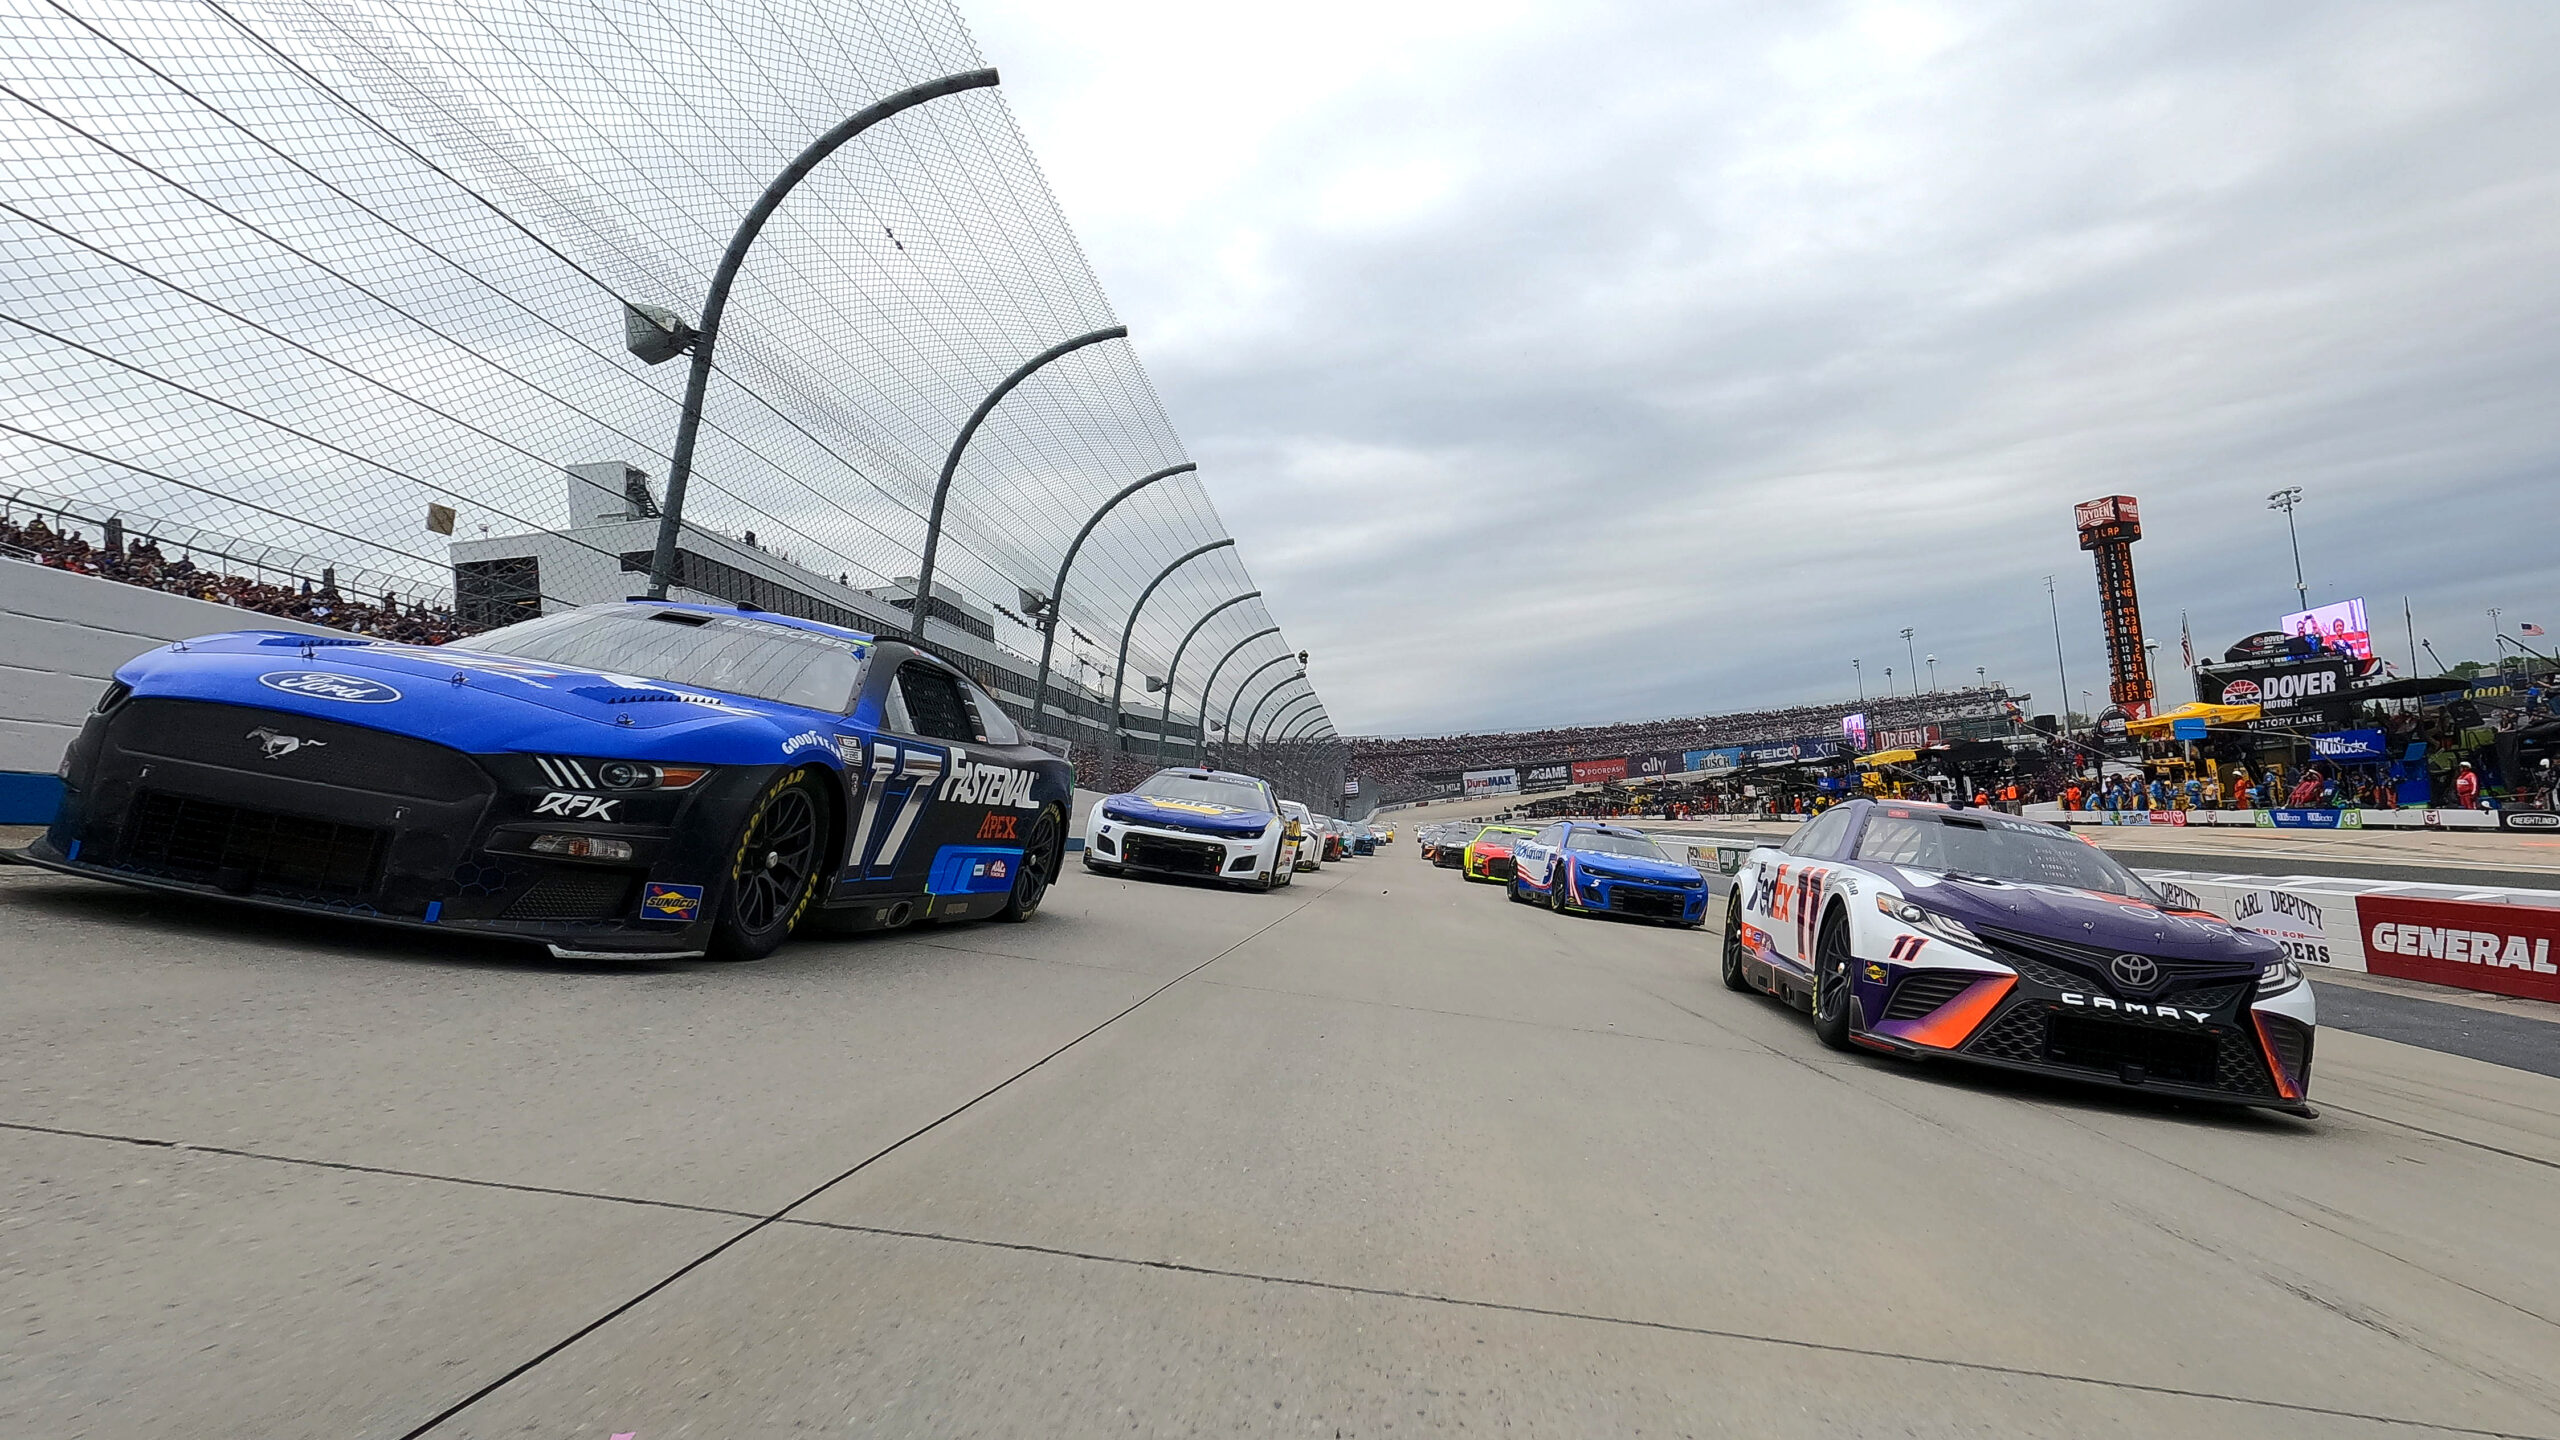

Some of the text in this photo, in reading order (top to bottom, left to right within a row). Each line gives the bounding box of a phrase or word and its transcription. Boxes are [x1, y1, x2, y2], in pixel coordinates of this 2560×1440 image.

[2076, 501, 2115, 525] DRYDENE
[721, 619, 855, 650] BUESCHER
[278, 673, 379, 699] Ford
[2263, 670, 2336, 700] DOVER
[2263, 698, 2293, 710] MOTOR
[2295, 713, 2323, 725] LANE
[782, 730, 842, 761] GOODYEAR
[1751, 746, 1801, 758] GEICO
[1587, 766, 1625, 776] DOORDASH
[1641, 755, 1666, 773] ally
[1700, 756, 1730, 768] BUSCH
[939, 747, 1039, 809] FASTENAL
[1466, 775, 1513, 789] DuraMAX
[532, 792, 621, 821] RFK
[848, 742, 943, 866] 17
[976, 810, 1018, 839] APEX
[1100, 824, 1112, 834] 9
[2257, 812, 2269, 825] 43
[2344, 812, 2358, 825] 43
[2512, 815, 2558, 826] FREIGHTLINER
[1590, 879, 1602, 888] 5
[1746, 862, 1795, 923] FedEx
[647, 896, 698, 909] SUNOCO
[2234, 890, 2324, 931] CARL DEPUTY
[1796, 866, 1829, 967] 11
[2282, 930, 2305, 939] SON
[1889, 933, 1930, 962] 11
[2280, 940, 2331, 964] DERS
[2372, 921, 2559, 975] GENERAL
[2061, 992, 2212, 1024] CAMRY
